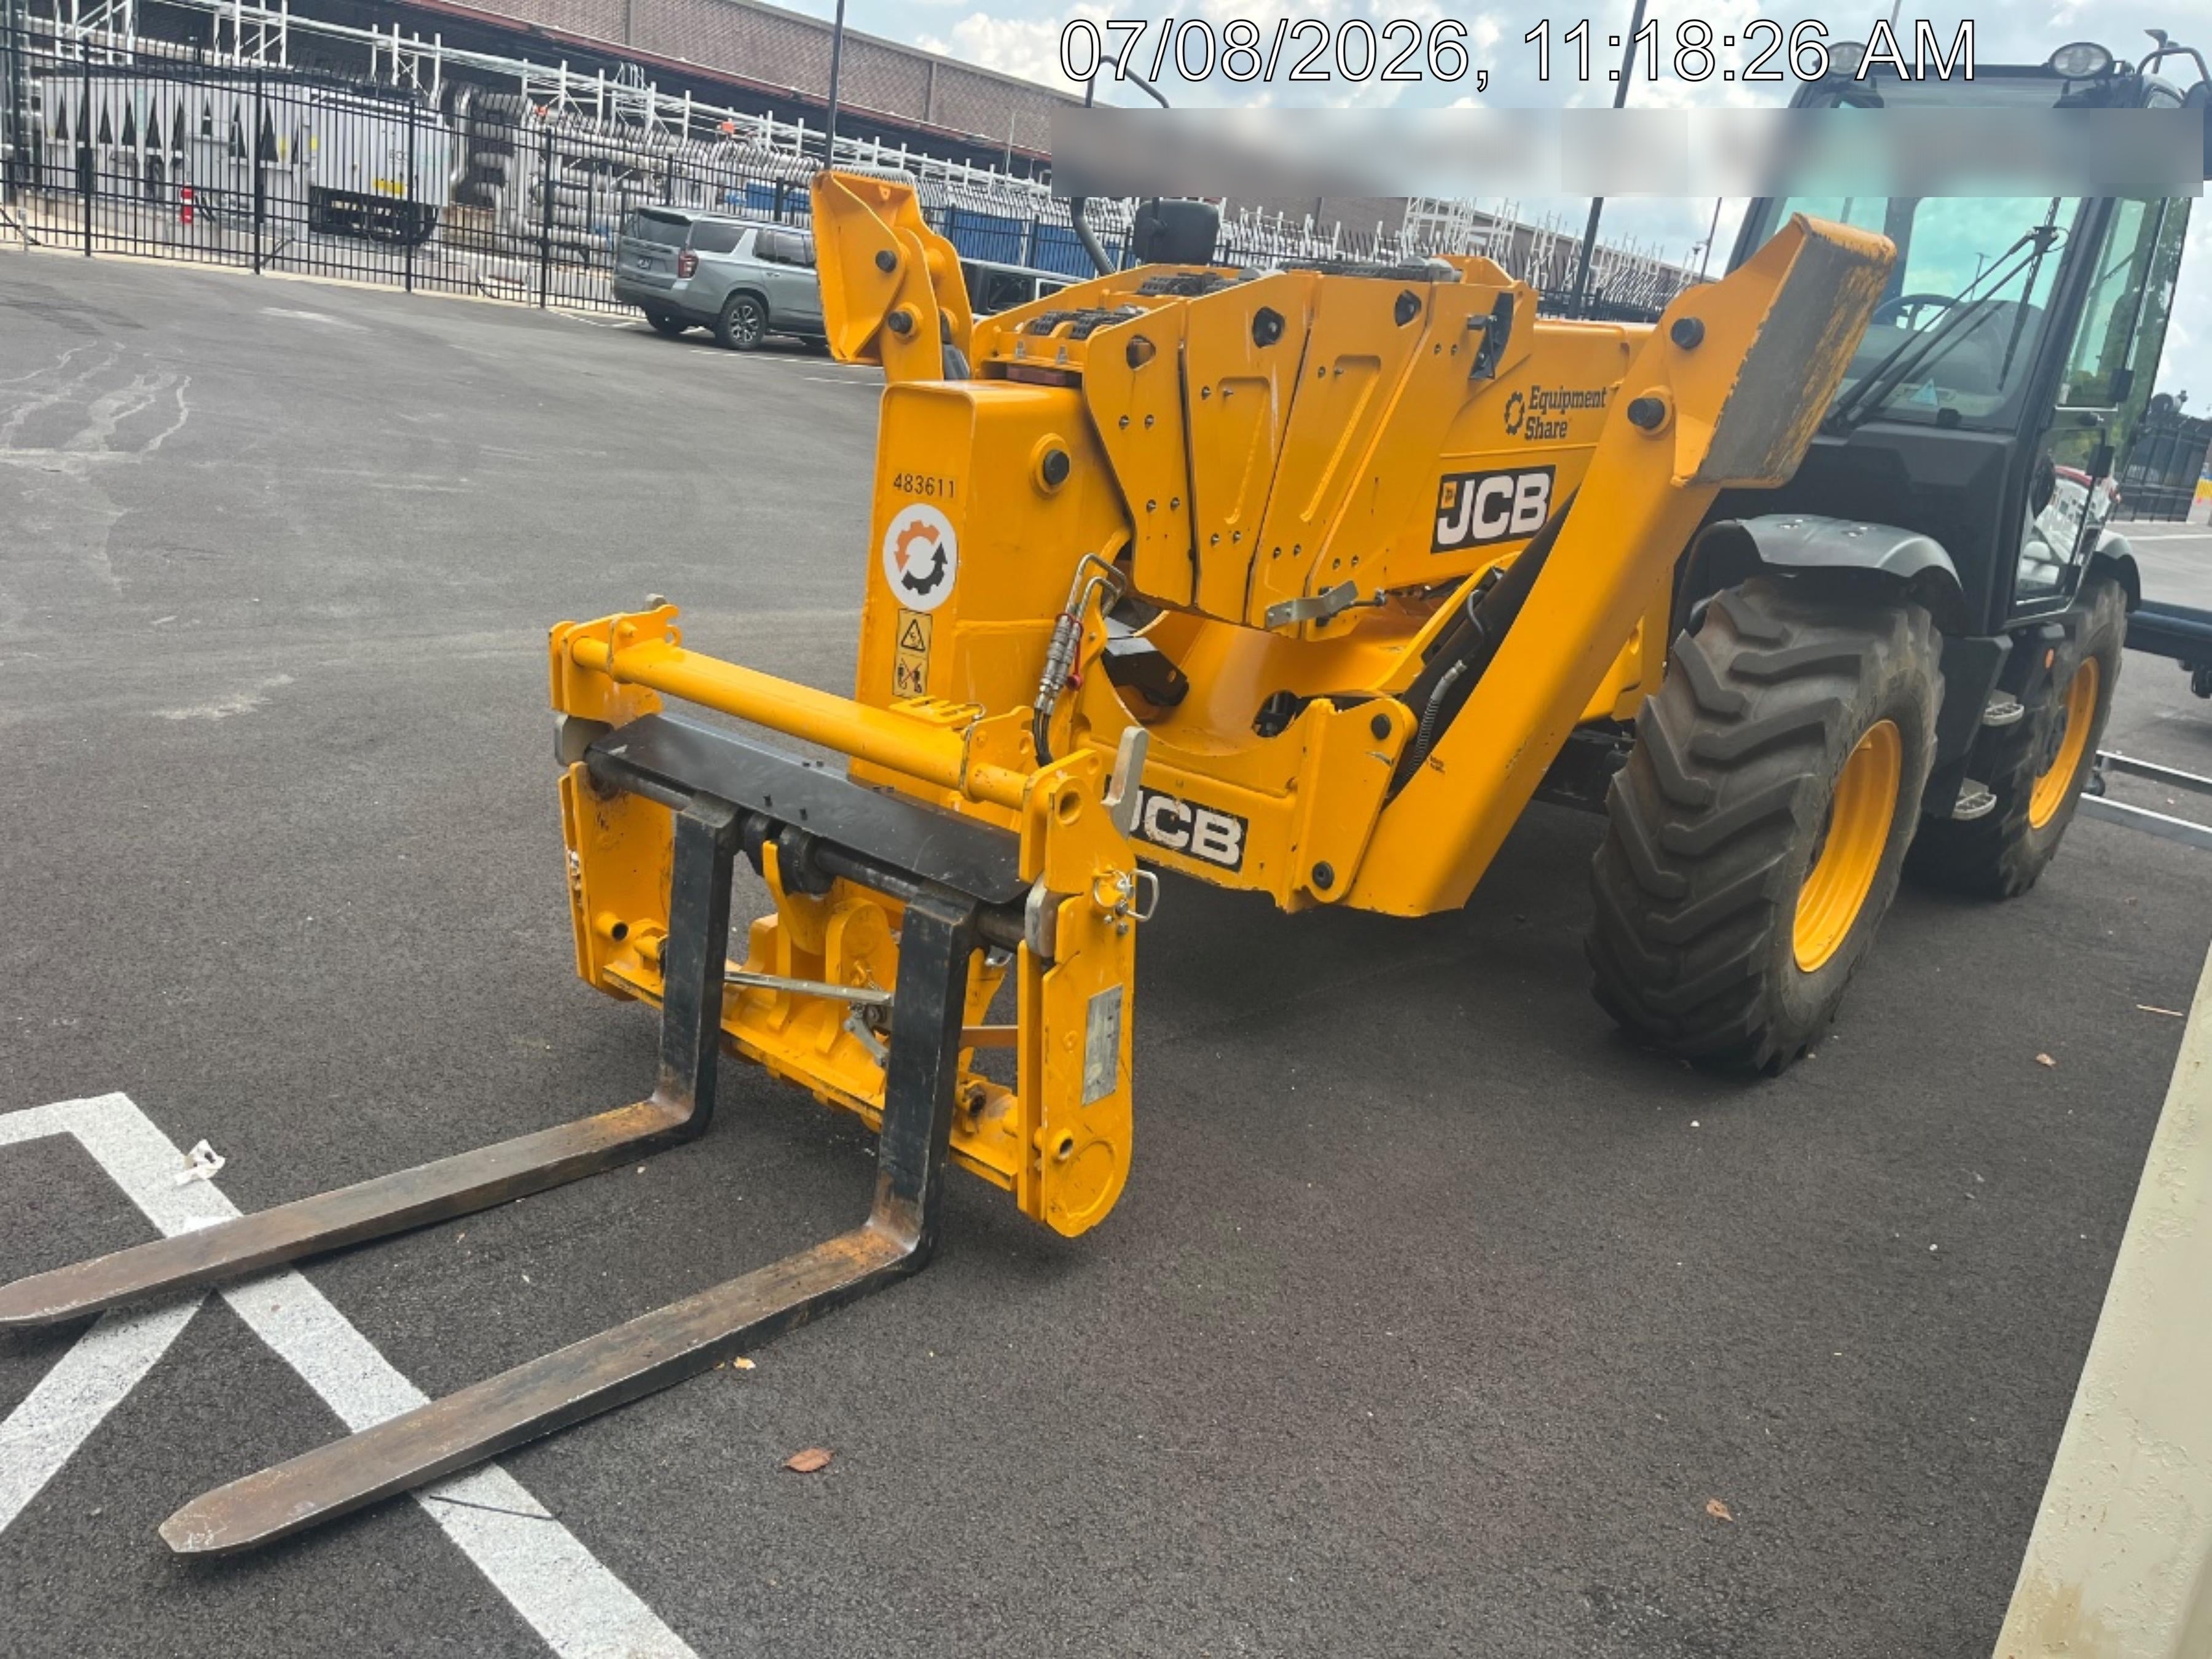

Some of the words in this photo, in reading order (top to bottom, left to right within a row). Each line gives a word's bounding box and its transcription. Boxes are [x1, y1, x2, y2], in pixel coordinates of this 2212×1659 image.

[1528, 385, 1607, 415] Equipment
[1524, 416, 1567, 441] Share
[893, 473, 954, 498] 483611
[1437, 473, 1551, 544] JCB
